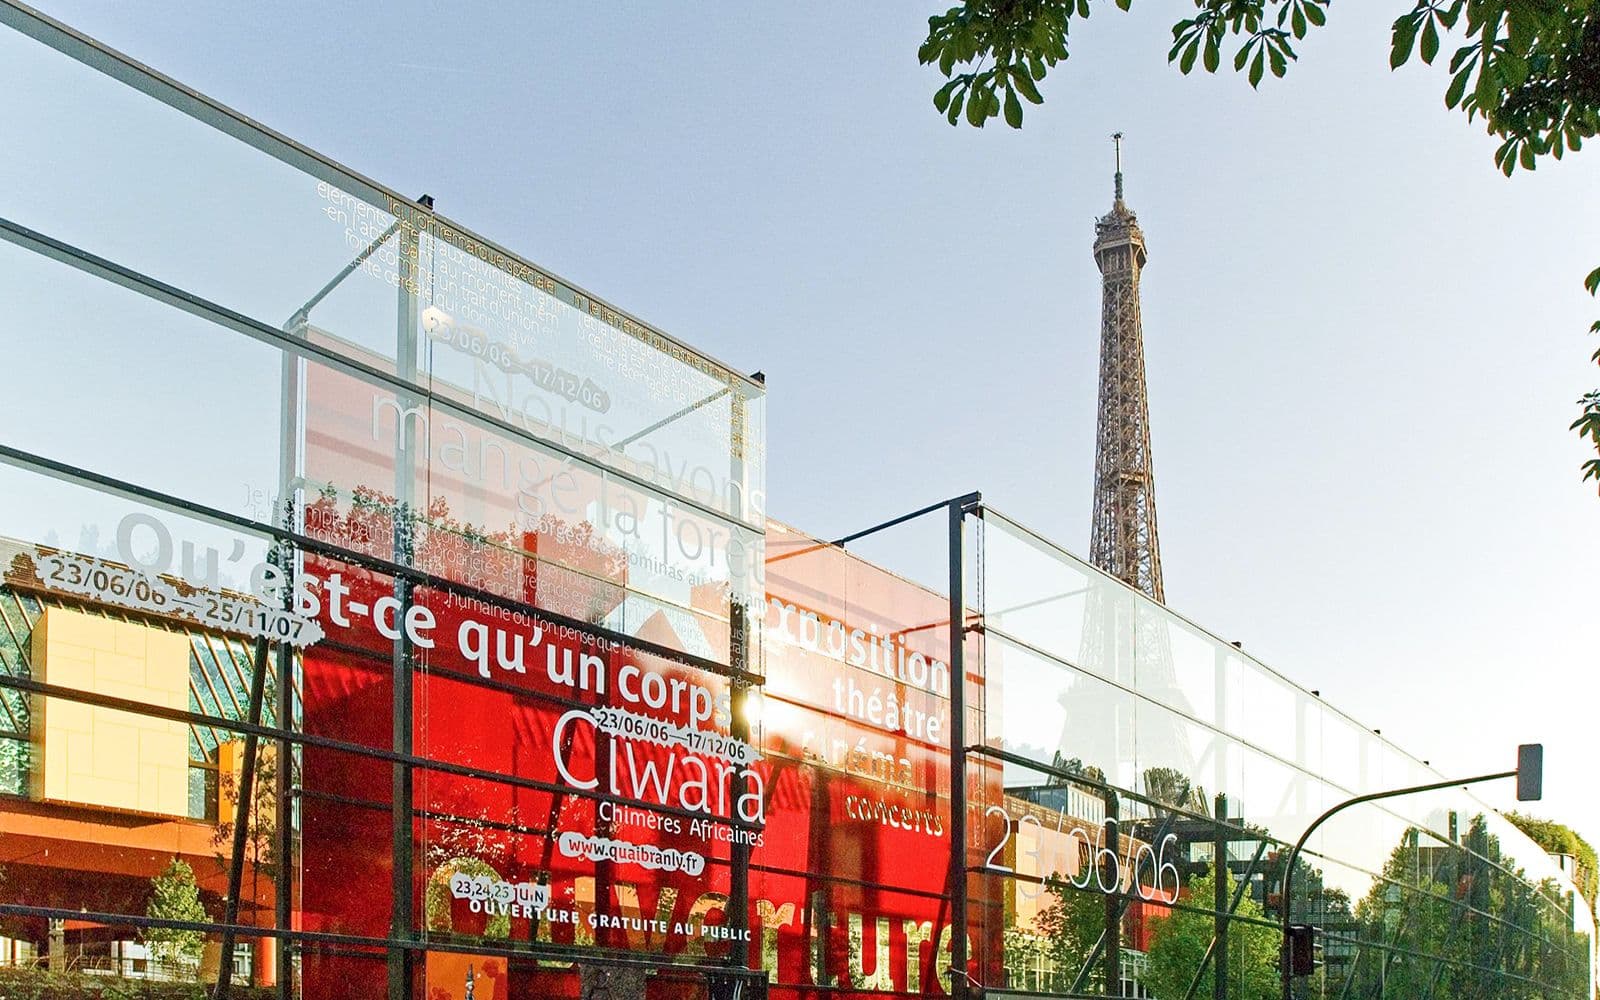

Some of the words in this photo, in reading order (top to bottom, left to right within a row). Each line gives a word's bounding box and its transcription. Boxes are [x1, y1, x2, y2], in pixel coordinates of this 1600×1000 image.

[439, 225, 505, 269] remarque
[439, 242, 465, 263] aux
[439, 276, 458, 296] un
[472, 357, 616, 460] Nous
[637, 441, 766, 524] avons
[372, 393, 580, 521] mangé
[600, 467, 640, 540] la
[657, 499, 766, 586] forêt
[49, 558, 167, 607] 23/06/06
[206, 598, 305, 640] 25/11/07
[447, 587, 511, 622] humaine
[512, 606, 530, 628] où
[534, 612, 558, 635] l'on
[559, 623, 596, 647] pense
[596, 633, 619, 655] que
[621, 640, 632, 658] le
[458, 606, 605, 696] qu'un
[618, 664, 734, 728] corps
[832, 676, 943, 745] théâtre
[552, 709, 766, 825] Ciwara
[598, 801, 682, 836] Chimères
[689, 817, 765, 848] Africaines
[845, 795, 943, 837] concerts
[568, 837, 698, 873] www.quaibranly.fr
[985, 805, 1180, 905] 23/06/06
[468, 899, 580, 925] OUVERTURE
[587, 913, 668, 934] GRATUITE
[673, 921, 695, 935] AU
[700, 925, 752, 942] PUBLIC
